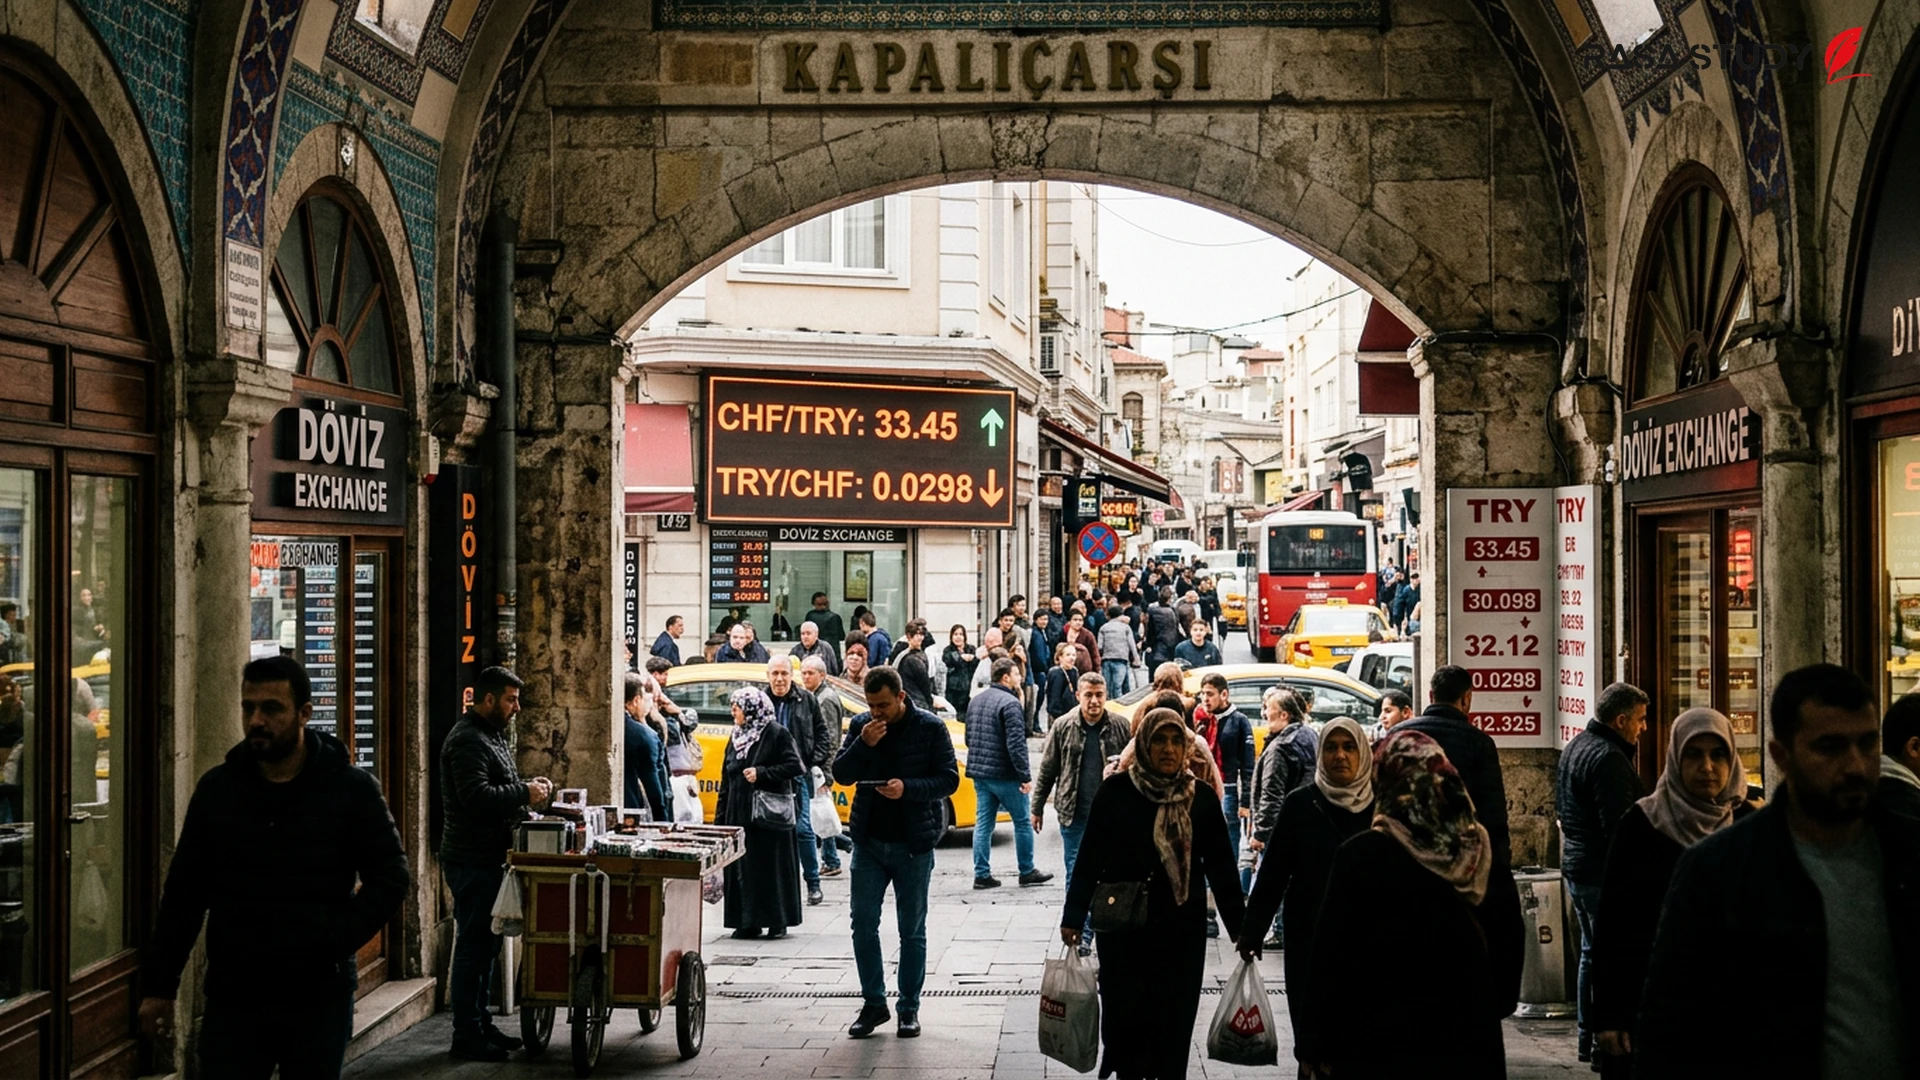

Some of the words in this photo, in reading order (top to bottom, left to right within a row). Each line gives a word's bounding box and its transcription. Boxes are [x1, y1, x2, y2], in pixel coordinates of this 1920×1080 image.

[782, 40, 1211, 99] KAPALIÇARŞI
[299, 399, 385, 470] DÖVİZ
[717, 402, 865, 436] CHF/TRY:
[874, 409, 958, 441] 33.45
[1623, 417, 1662, 481] DÖVİZ
[1665, 406, 1749, 474] EXCHANGE
[295, 473, 387, 512] EXCHANGE
[716, 467, 863, 499] TRY/CHF:
[872, 471, 973, 503] 0.0298
[1467, 499, 1537, 523] TRY
[1557, 497, 1586, 523] TRY
[1473, 540, 1531, 558] 33.45
[461, 493, 477, 664] DÖVİZ
[1468, 593, 1536, 610] 30.098
[1464, 634, 1539, 657] 32.12
[1472, 672, 1536, 688] 0.0298
[1539, 925, 1553, 944] B
